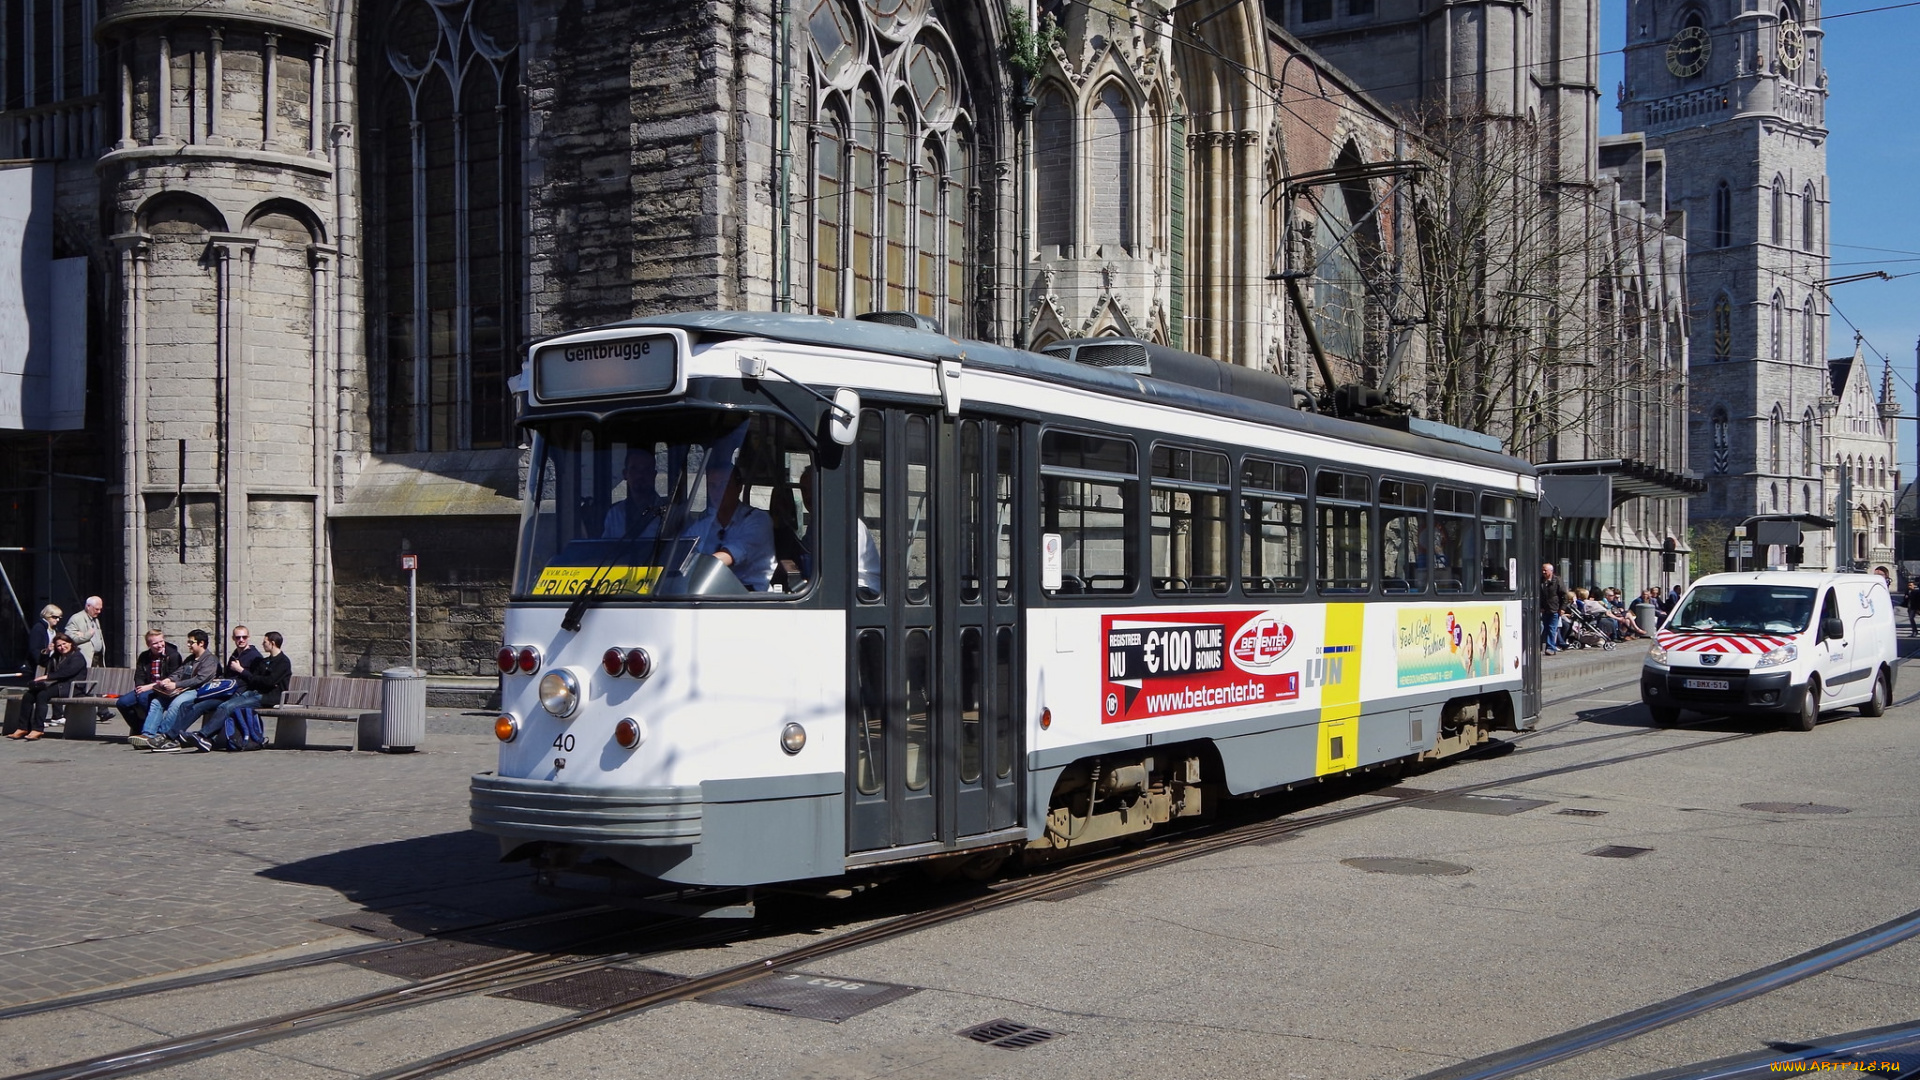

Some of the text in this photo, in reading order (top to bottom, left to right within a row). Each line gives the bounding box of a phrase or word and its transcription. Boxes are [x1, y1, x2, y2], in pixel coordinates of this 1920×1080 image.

[564, 341, 650, 363] Gentbrugge
[1109, 633, 1142, 647] REGISTREER
[1194, 629, 1222, 649] ONLINE
[1400, 622, 1414, 649] Feel
[1415, 613, 1432, 645] Good
[1143, 630, 1192, 673] €100
[1195, 650, 1221, 670] BONUS
[1109, 651, 1126, 678] NU
[1146, 679, 1265, 714] www.betcenter.be
[552, 733, 576, 752] 40
